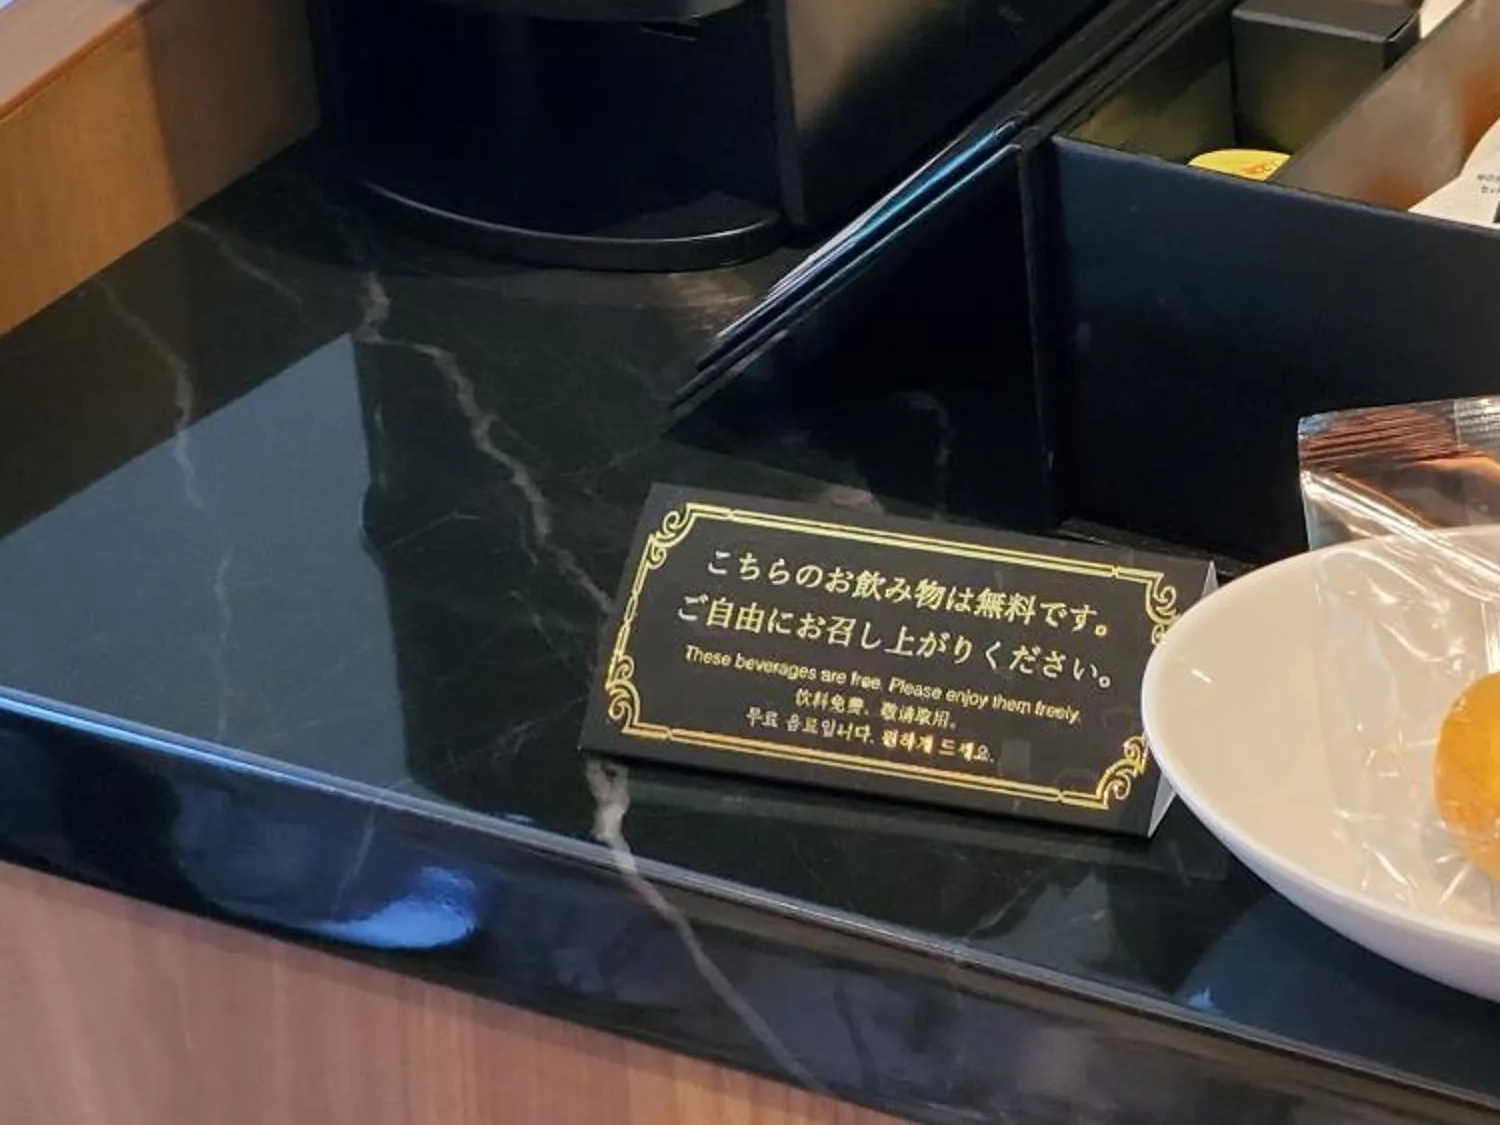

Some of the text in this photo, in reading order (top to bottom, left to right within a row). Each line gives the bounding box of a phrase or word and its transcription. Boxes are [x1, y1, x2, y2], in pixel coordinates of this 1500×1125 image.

[707, 550, 1108, 637] こちらのお飲み物は無料です。
[677, 593, 1111, 689] ご自由にお召し上がりください。
[686, 645, 732, 666] These
[734, 652, 817, 680] beverages
[821, 669, 847, 685] are
[888, 677, 943, 700] Please
[946, 688, 988, 709] enjoy
[992, 694, 1031, 714] them
[1034, 700, 1082, 724] freely.
[747, 706, 778, 729] 무료
[786, 713, 875, 745] 음료입니다.
